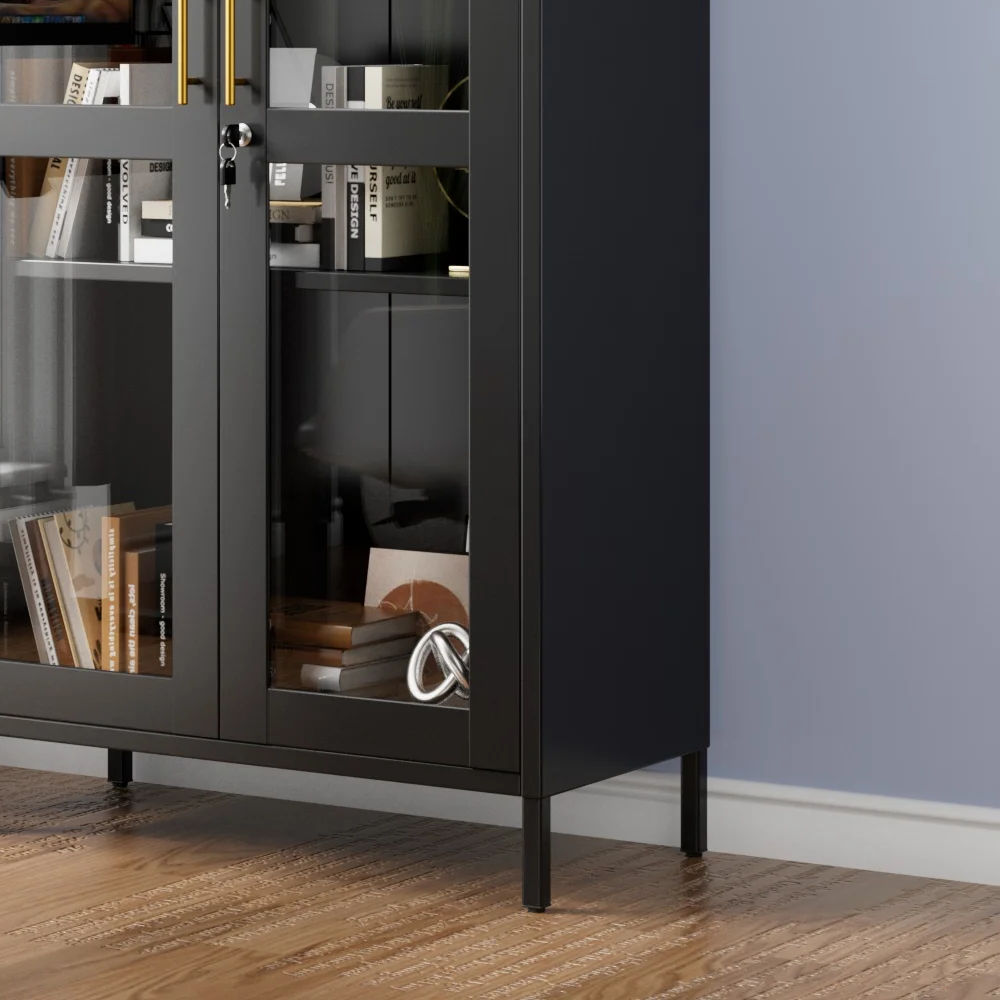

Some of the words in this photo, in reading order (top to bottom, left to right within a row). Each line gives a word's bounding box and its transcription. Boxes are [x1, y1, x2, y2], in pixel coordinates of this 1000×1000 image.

[105, 183, 113, 200] good
[105, 201, 113, 224] design
[350, 183, 359, 239] DESIGN
[159, 572, 167, 613] Showroom
[158, 620, 167, 640] good
[158, 641, 167, 667] design
